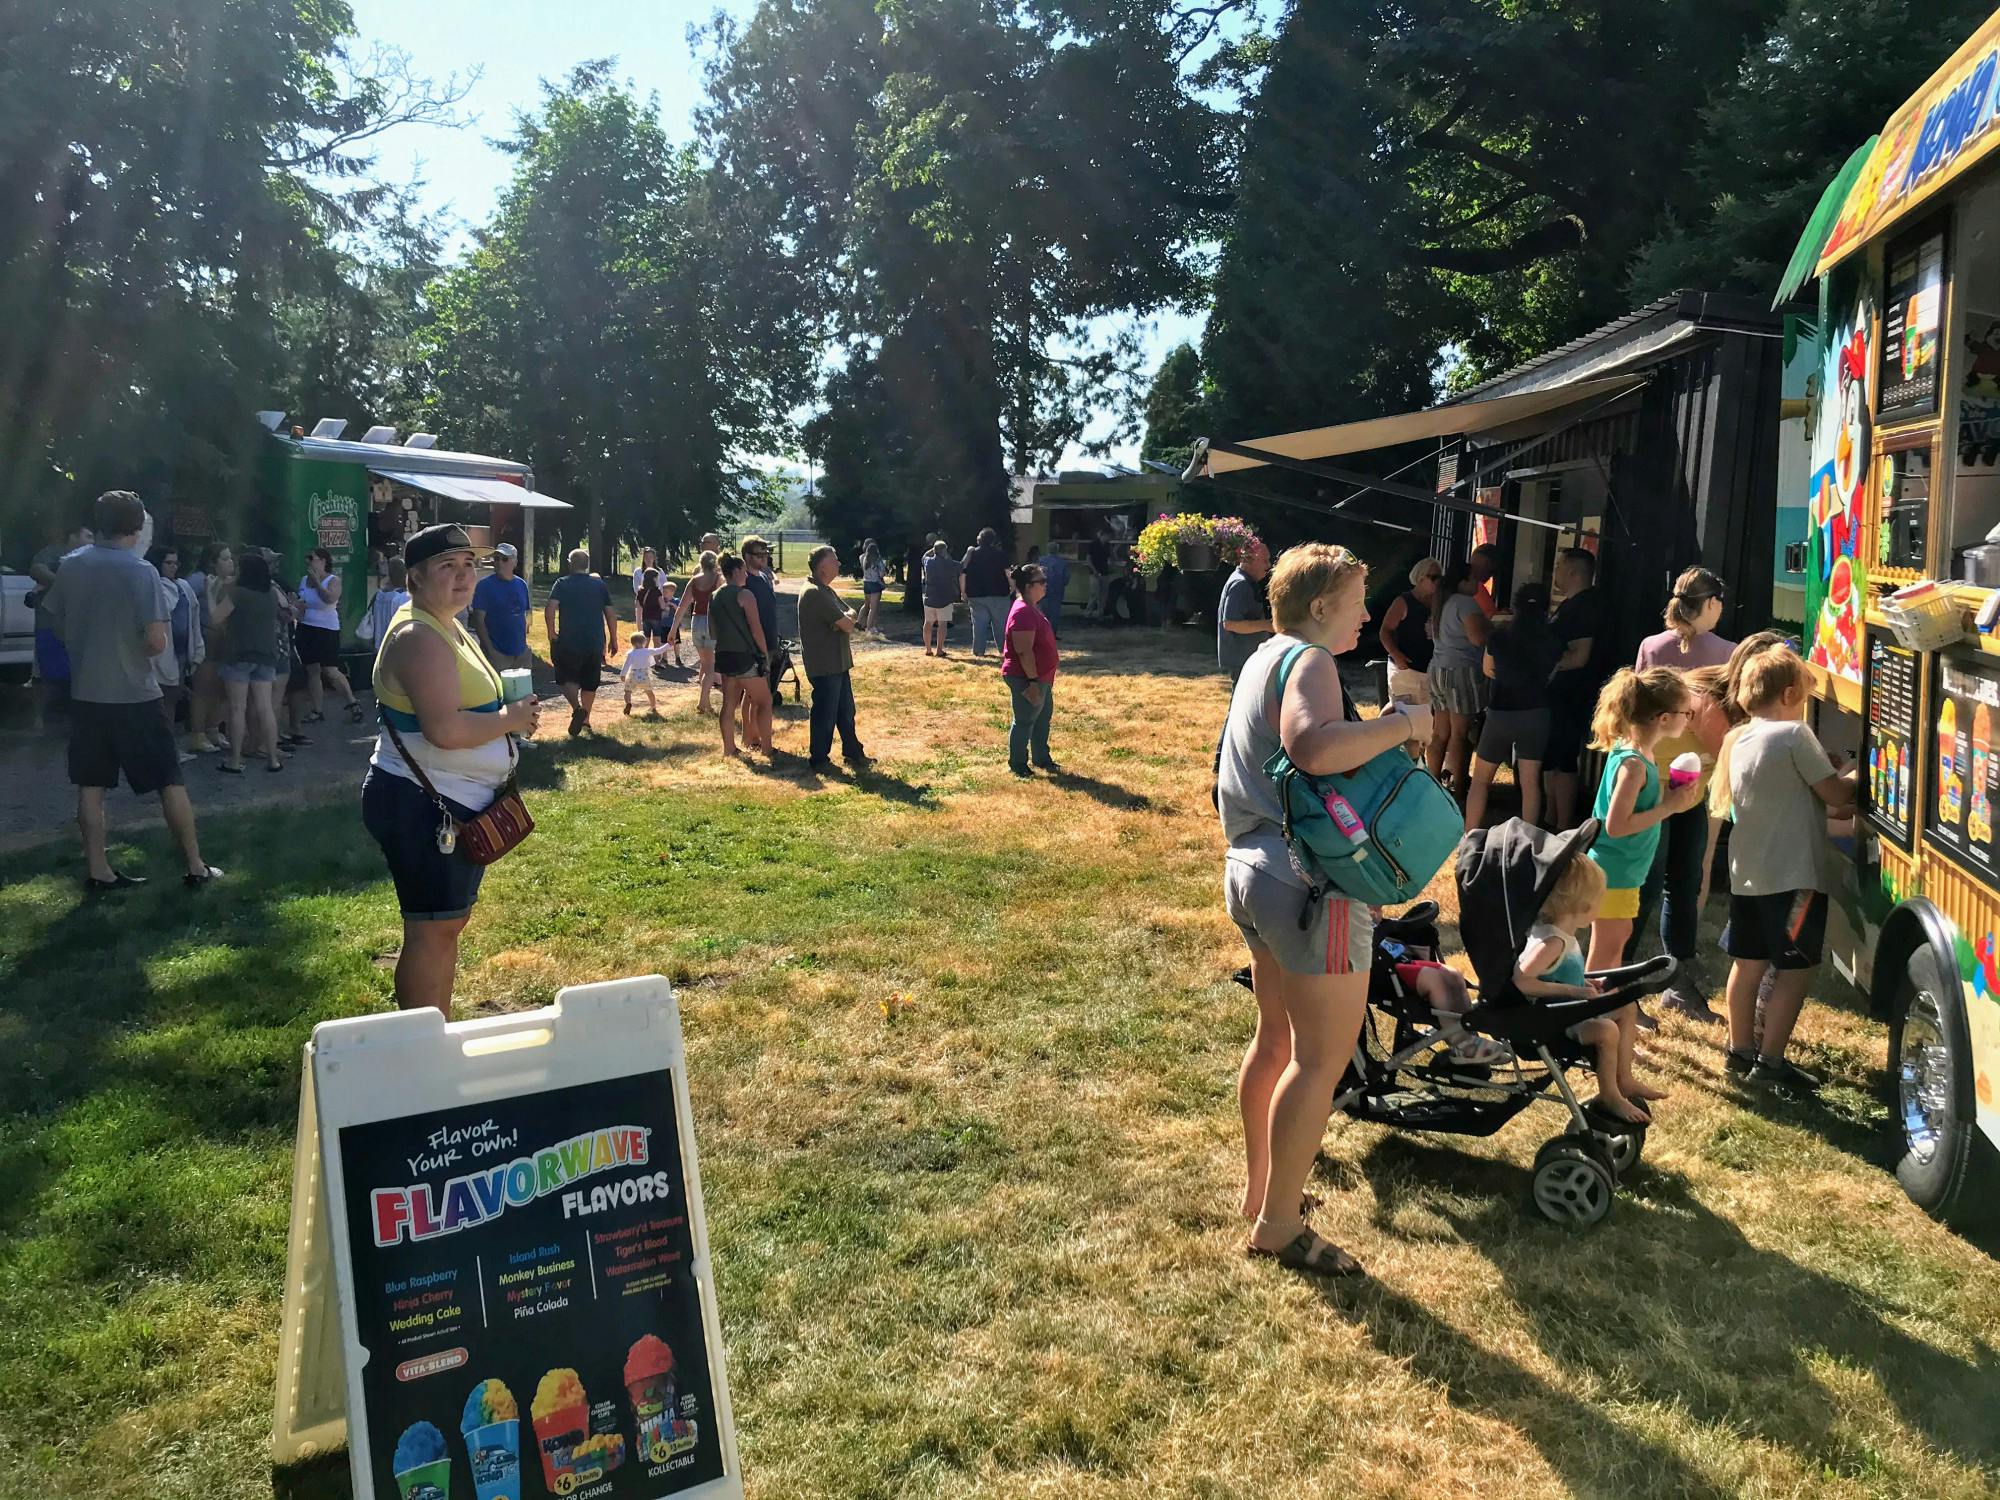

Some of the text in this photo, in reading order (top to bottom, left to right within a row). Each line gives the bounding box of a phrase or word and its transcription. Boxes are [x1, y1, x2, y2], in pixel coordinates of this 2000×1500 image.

[370, 1125, 649, 1247] FLAVORWAVE
[561, 1171, 669, 1219] FLAVORS
[509, 1243, 560, 1264] Island Rush
[385, 1268, 458, 1294] Blue Raspberry
[499, 1259, 575, 1286] Monkey Business
[422, 1289, 453, 1304] Cherry
[507, 1286, 542, 1302] Mystery
[389, 1305, 461, 1331] Wedding Cake
[514, 1296, 568, 1319] Piña Colada
[648, 1454, 695, 1478] KOLLECTABLE
[580, 1482, 613, 1499] CHANGE
